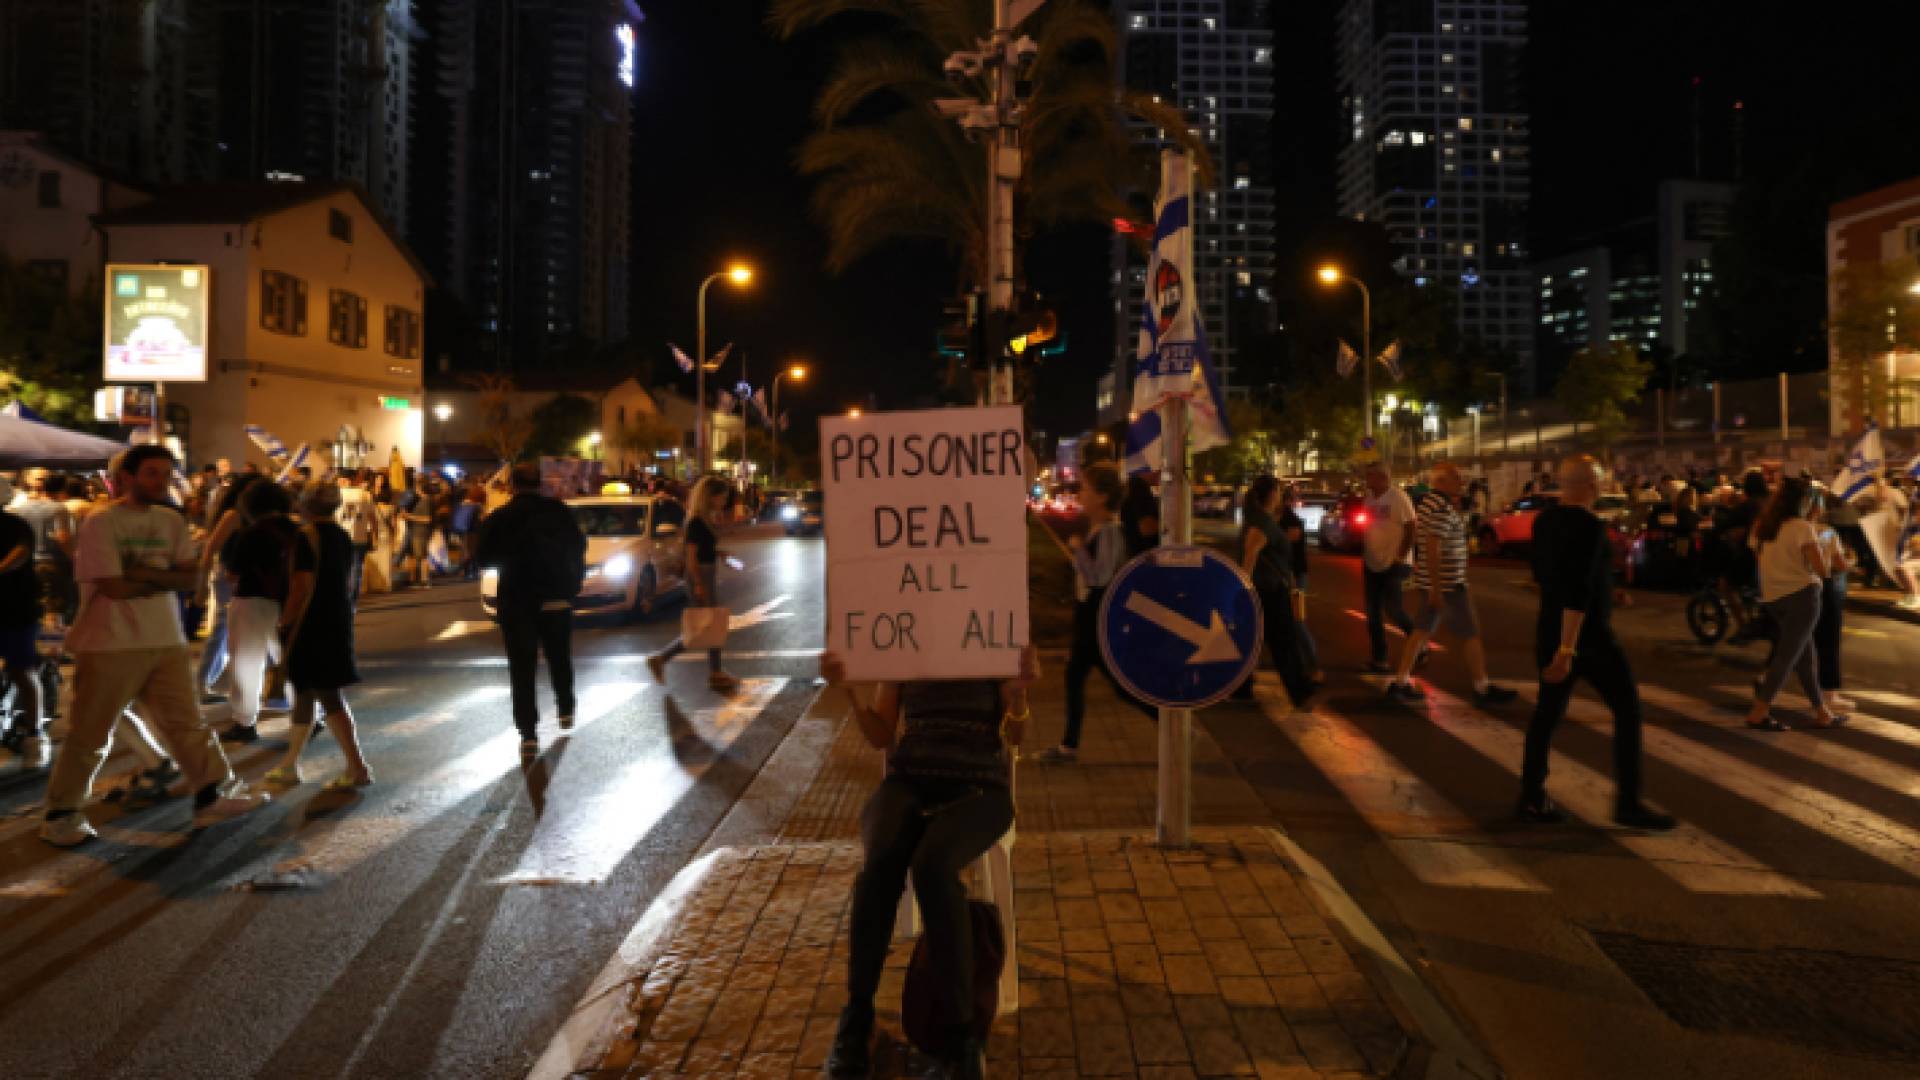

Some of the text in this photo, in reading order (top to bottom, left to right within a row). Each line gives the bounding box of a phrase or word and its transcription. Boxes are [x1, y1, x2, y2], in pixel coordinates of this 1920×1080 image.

[831, 429, 1022, 482] PRISONER
[874, 502, 990, 548] DEAL
[899, 562, 968, 593] ALL
[845, 609, 1029, 651] FOR ALL
